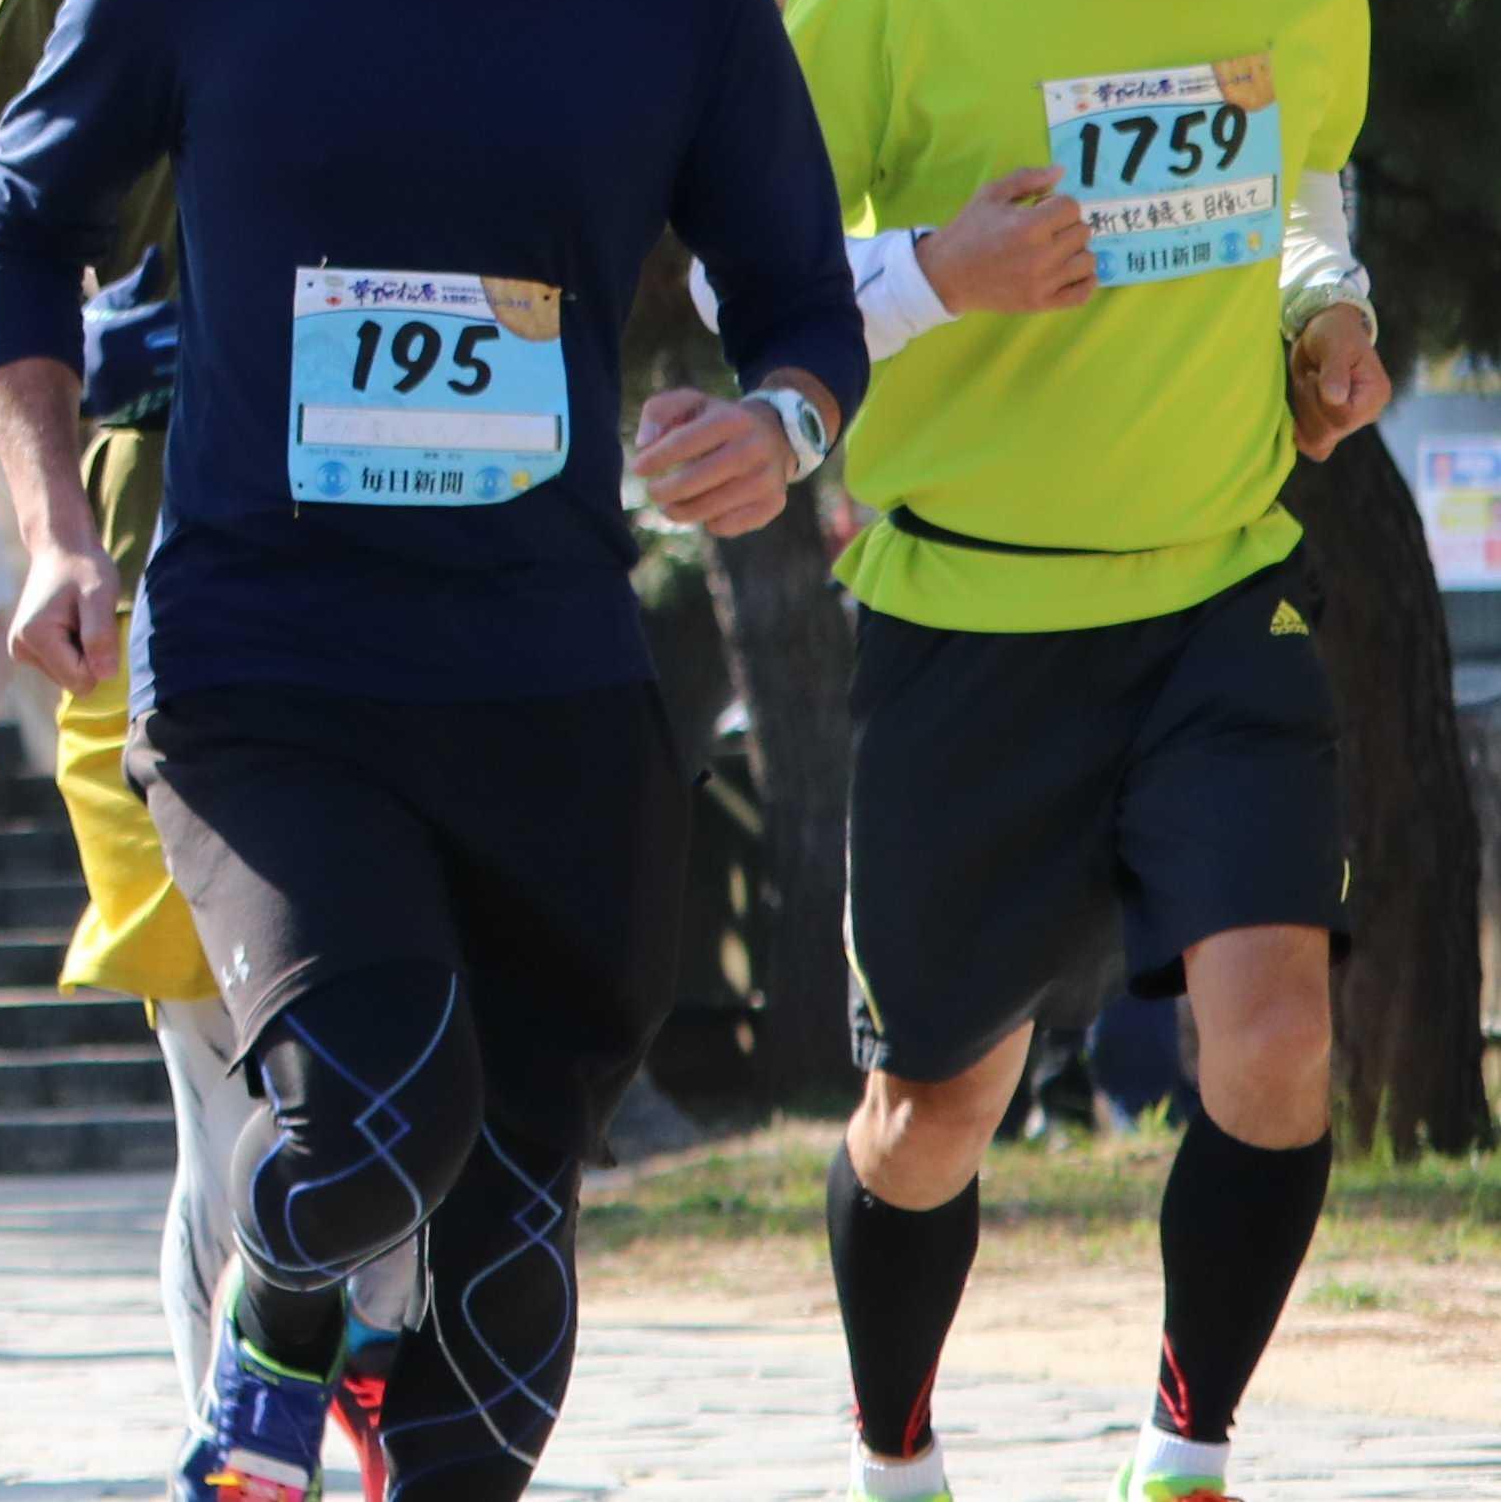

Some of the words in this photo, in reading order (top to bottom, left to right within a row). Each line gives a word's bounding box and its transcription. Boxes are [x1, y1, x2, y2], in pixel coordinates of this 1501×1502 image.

[1079, 103, 1247, 188] 1759
[1127, 241, 1211, 273] 毎日新聞
[352, 319, 500, 396] 195
[360, 466, 465, 495] 毎日新聞
